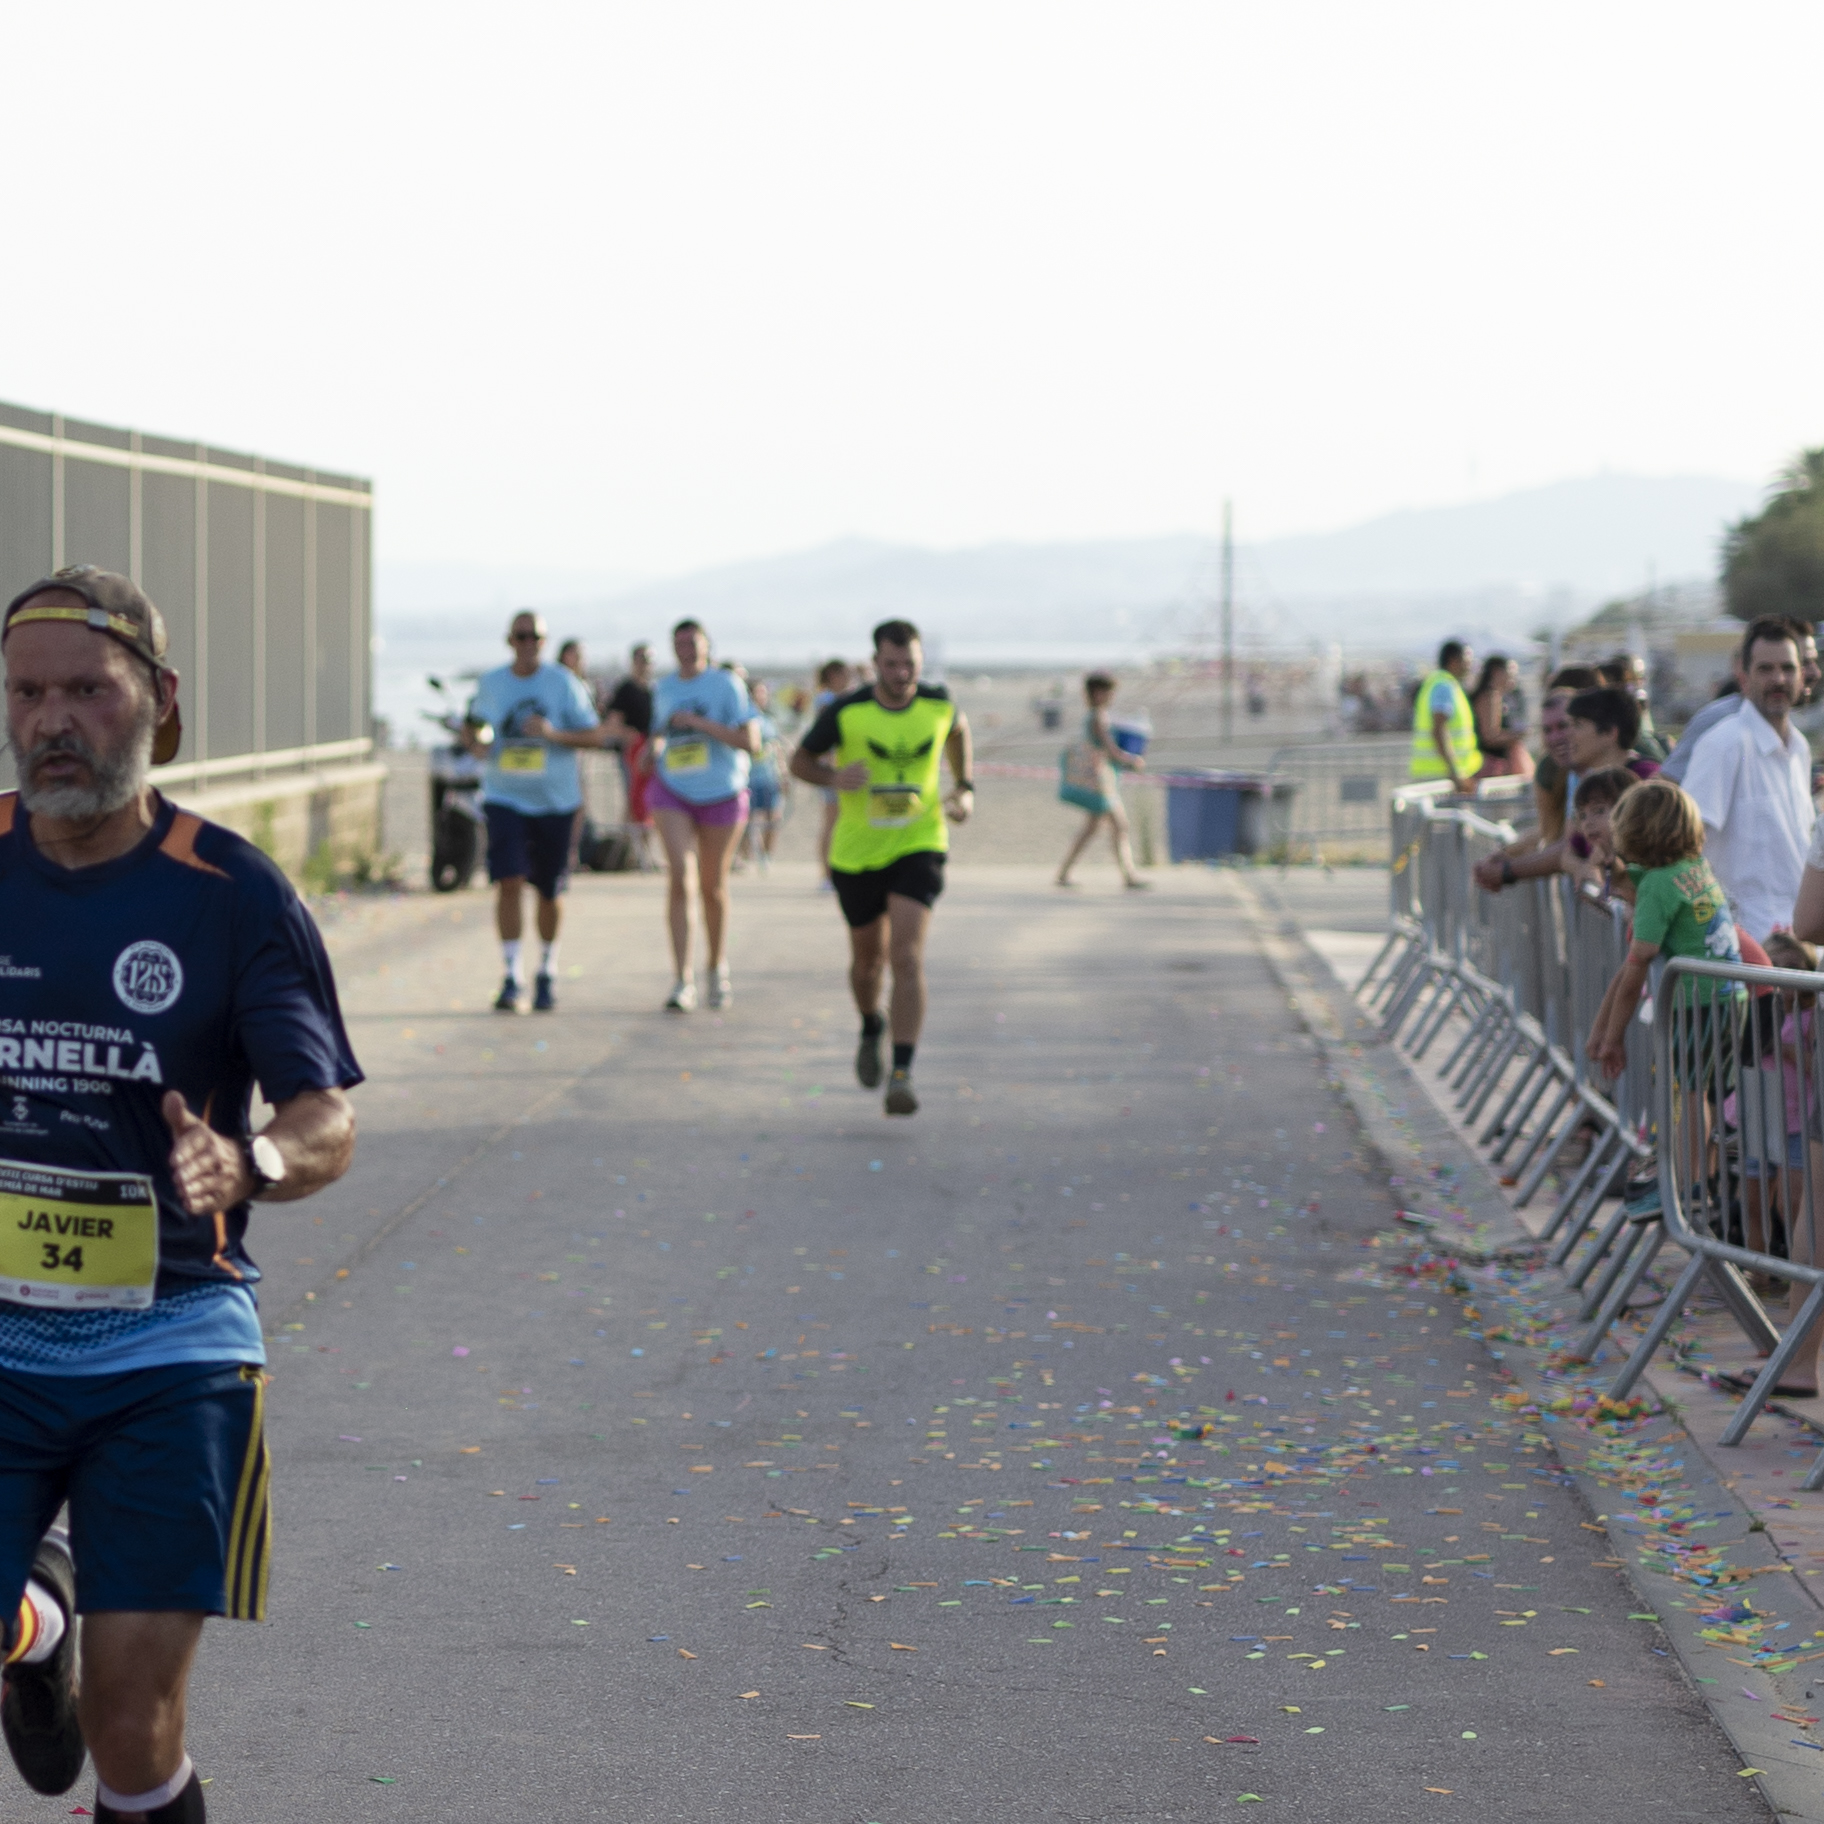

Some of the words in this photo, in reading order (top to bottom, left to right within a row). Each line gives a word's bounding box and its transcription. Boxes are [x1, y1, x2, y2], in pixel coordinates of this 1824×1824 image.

[30, 1020, 134, 1044] NOCTURNA
[72, 1078, 113, 1094] 1900
[21, 1170, 54, 1185] CURSA
[24, 1182, 38, 1195] DE
[39, 1185, 63, 1198] MAR
[17, 1210, 114, 1240] JAVIER
[40, 1242, 84, 1273] 34
